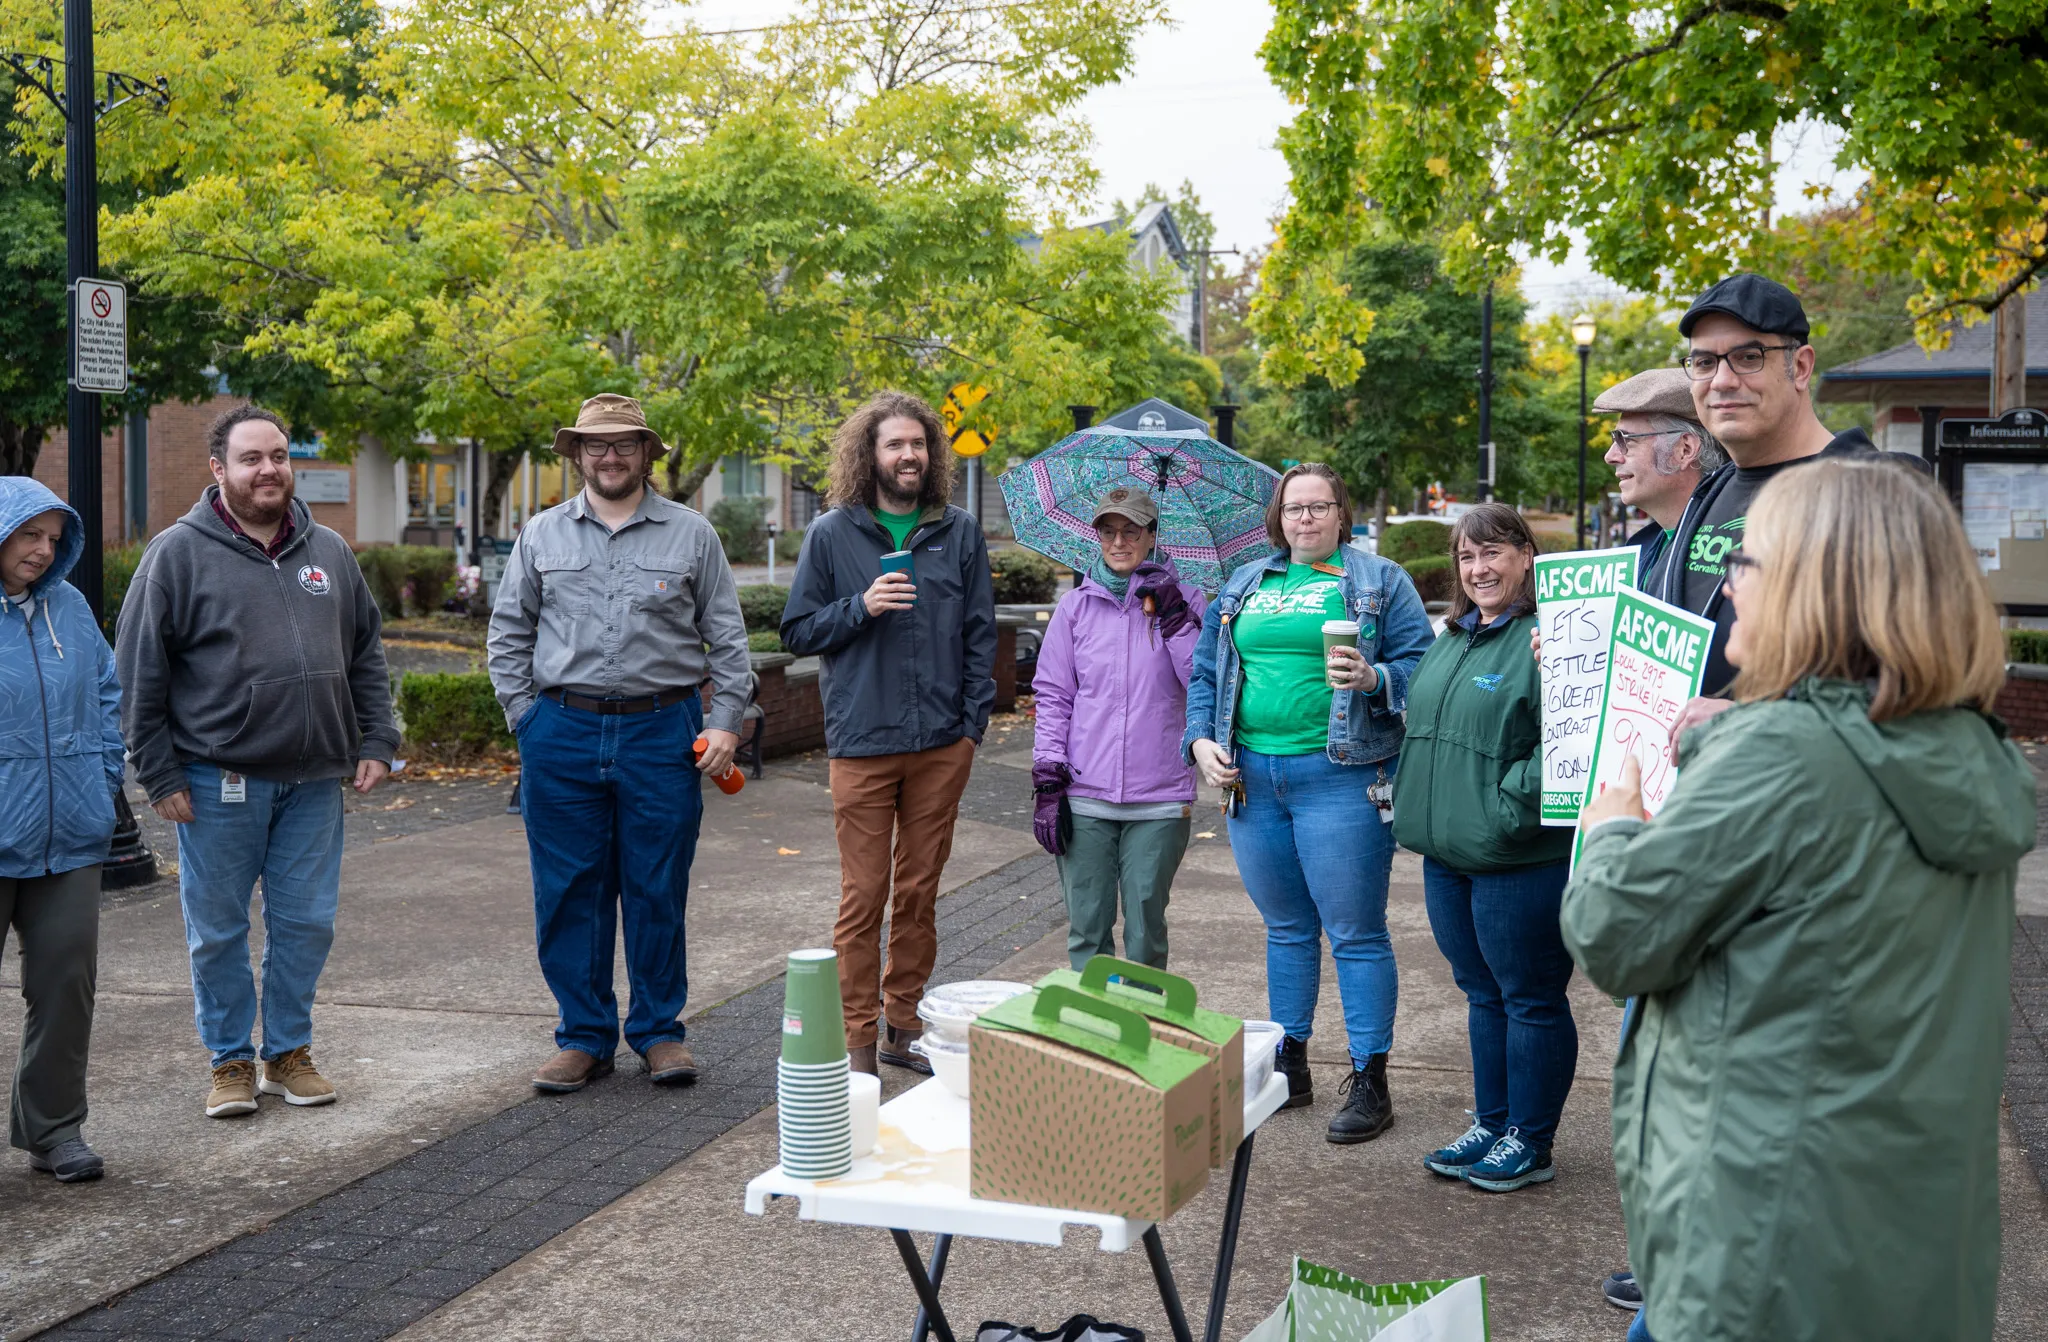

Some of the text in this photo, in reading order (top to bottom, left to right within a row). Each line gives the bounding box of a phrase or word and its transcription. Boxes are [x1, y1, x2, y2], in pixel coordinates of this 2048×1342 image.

[87, 318, 95, 326] City
[79, 326, 92, 335] Transit
[93, 327, 106, 336] Center
[84, 364, 98, 372] Plazas
[1970, 425, 2040, 438] Information
[1689, 562, 1718, 575] Corvallis
[1538, 561, 1628, 599] AFSCME
[1245, 594, 1326, 609] AFSCME
[1296, 606, 1327, 615] Happen
[1616, 604, 1701, 672] AFSCME
[1542, 651, 1607, 683] SETTLE
[1642, 662, 1666, 689] 2975
[1548, 684, 1604, 713] GREAT
[1616, 672, 1680, 722] STRIKE VOTE
[1542, 793, 1572, 806] OREGON
